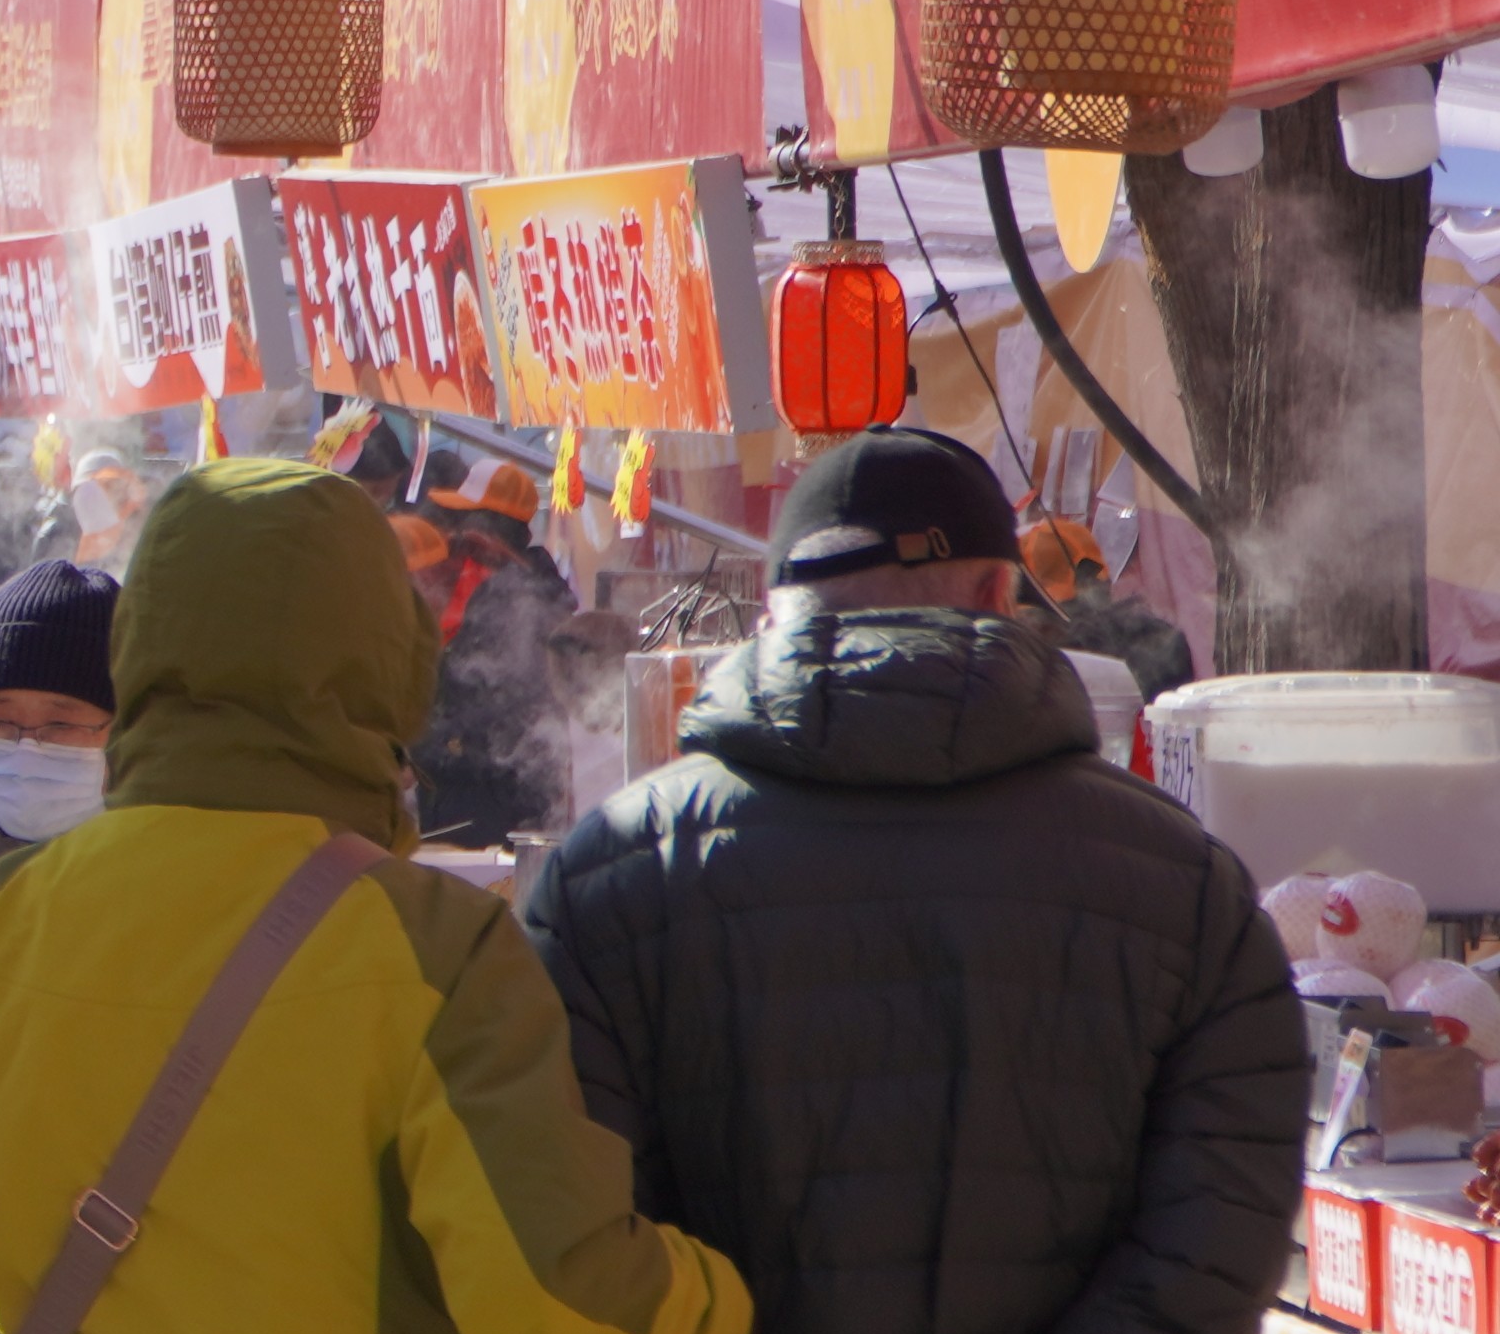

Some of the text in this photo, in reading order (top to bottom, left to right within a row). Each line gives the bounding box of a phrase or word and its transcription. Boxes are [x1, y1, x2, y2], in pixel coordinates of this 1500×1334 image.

[110, 222, 223, 364] 台湾蚵仔煎
[516, 206, 666, 393] 暖冬热橙茶
